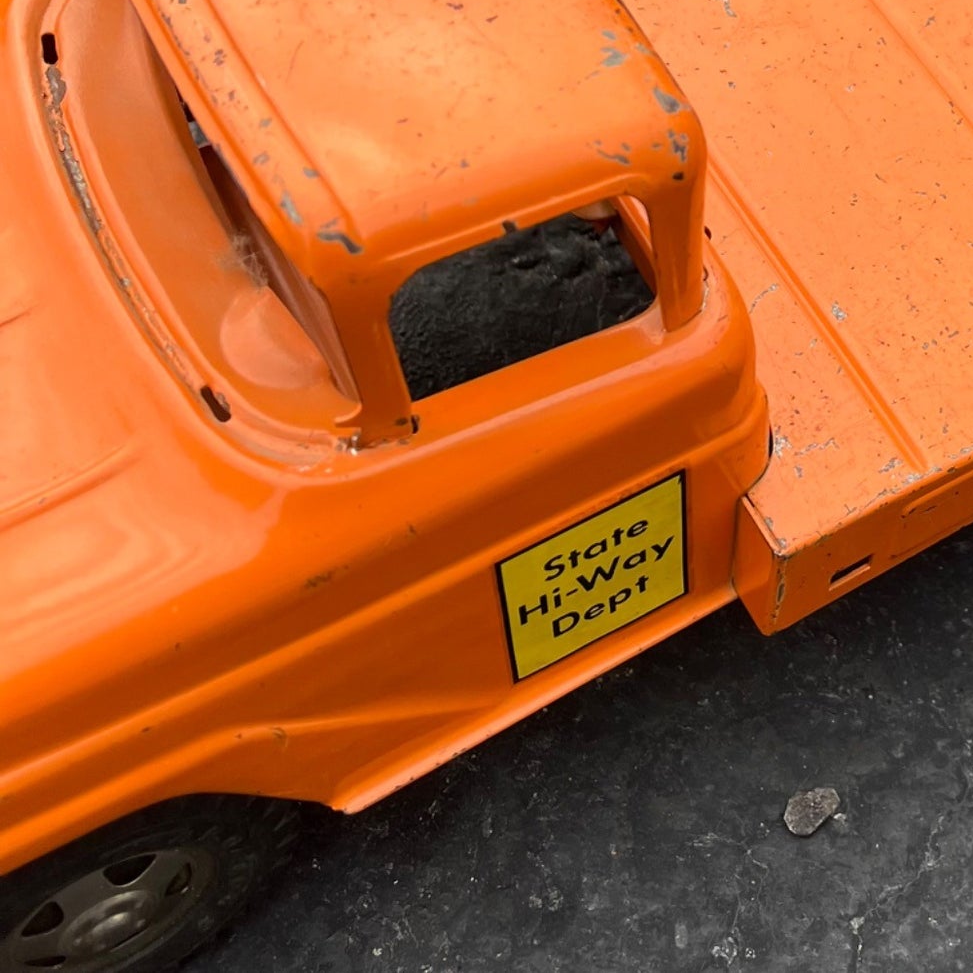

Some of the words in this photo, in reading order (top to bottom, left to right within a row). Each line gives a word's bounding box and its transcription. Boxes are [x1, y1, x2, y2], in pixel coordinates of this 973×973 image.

[518, 535, 675, 625] Hi-Way
[543, 519, 649, 582] State
[552, 574, 649, 638] Dept
